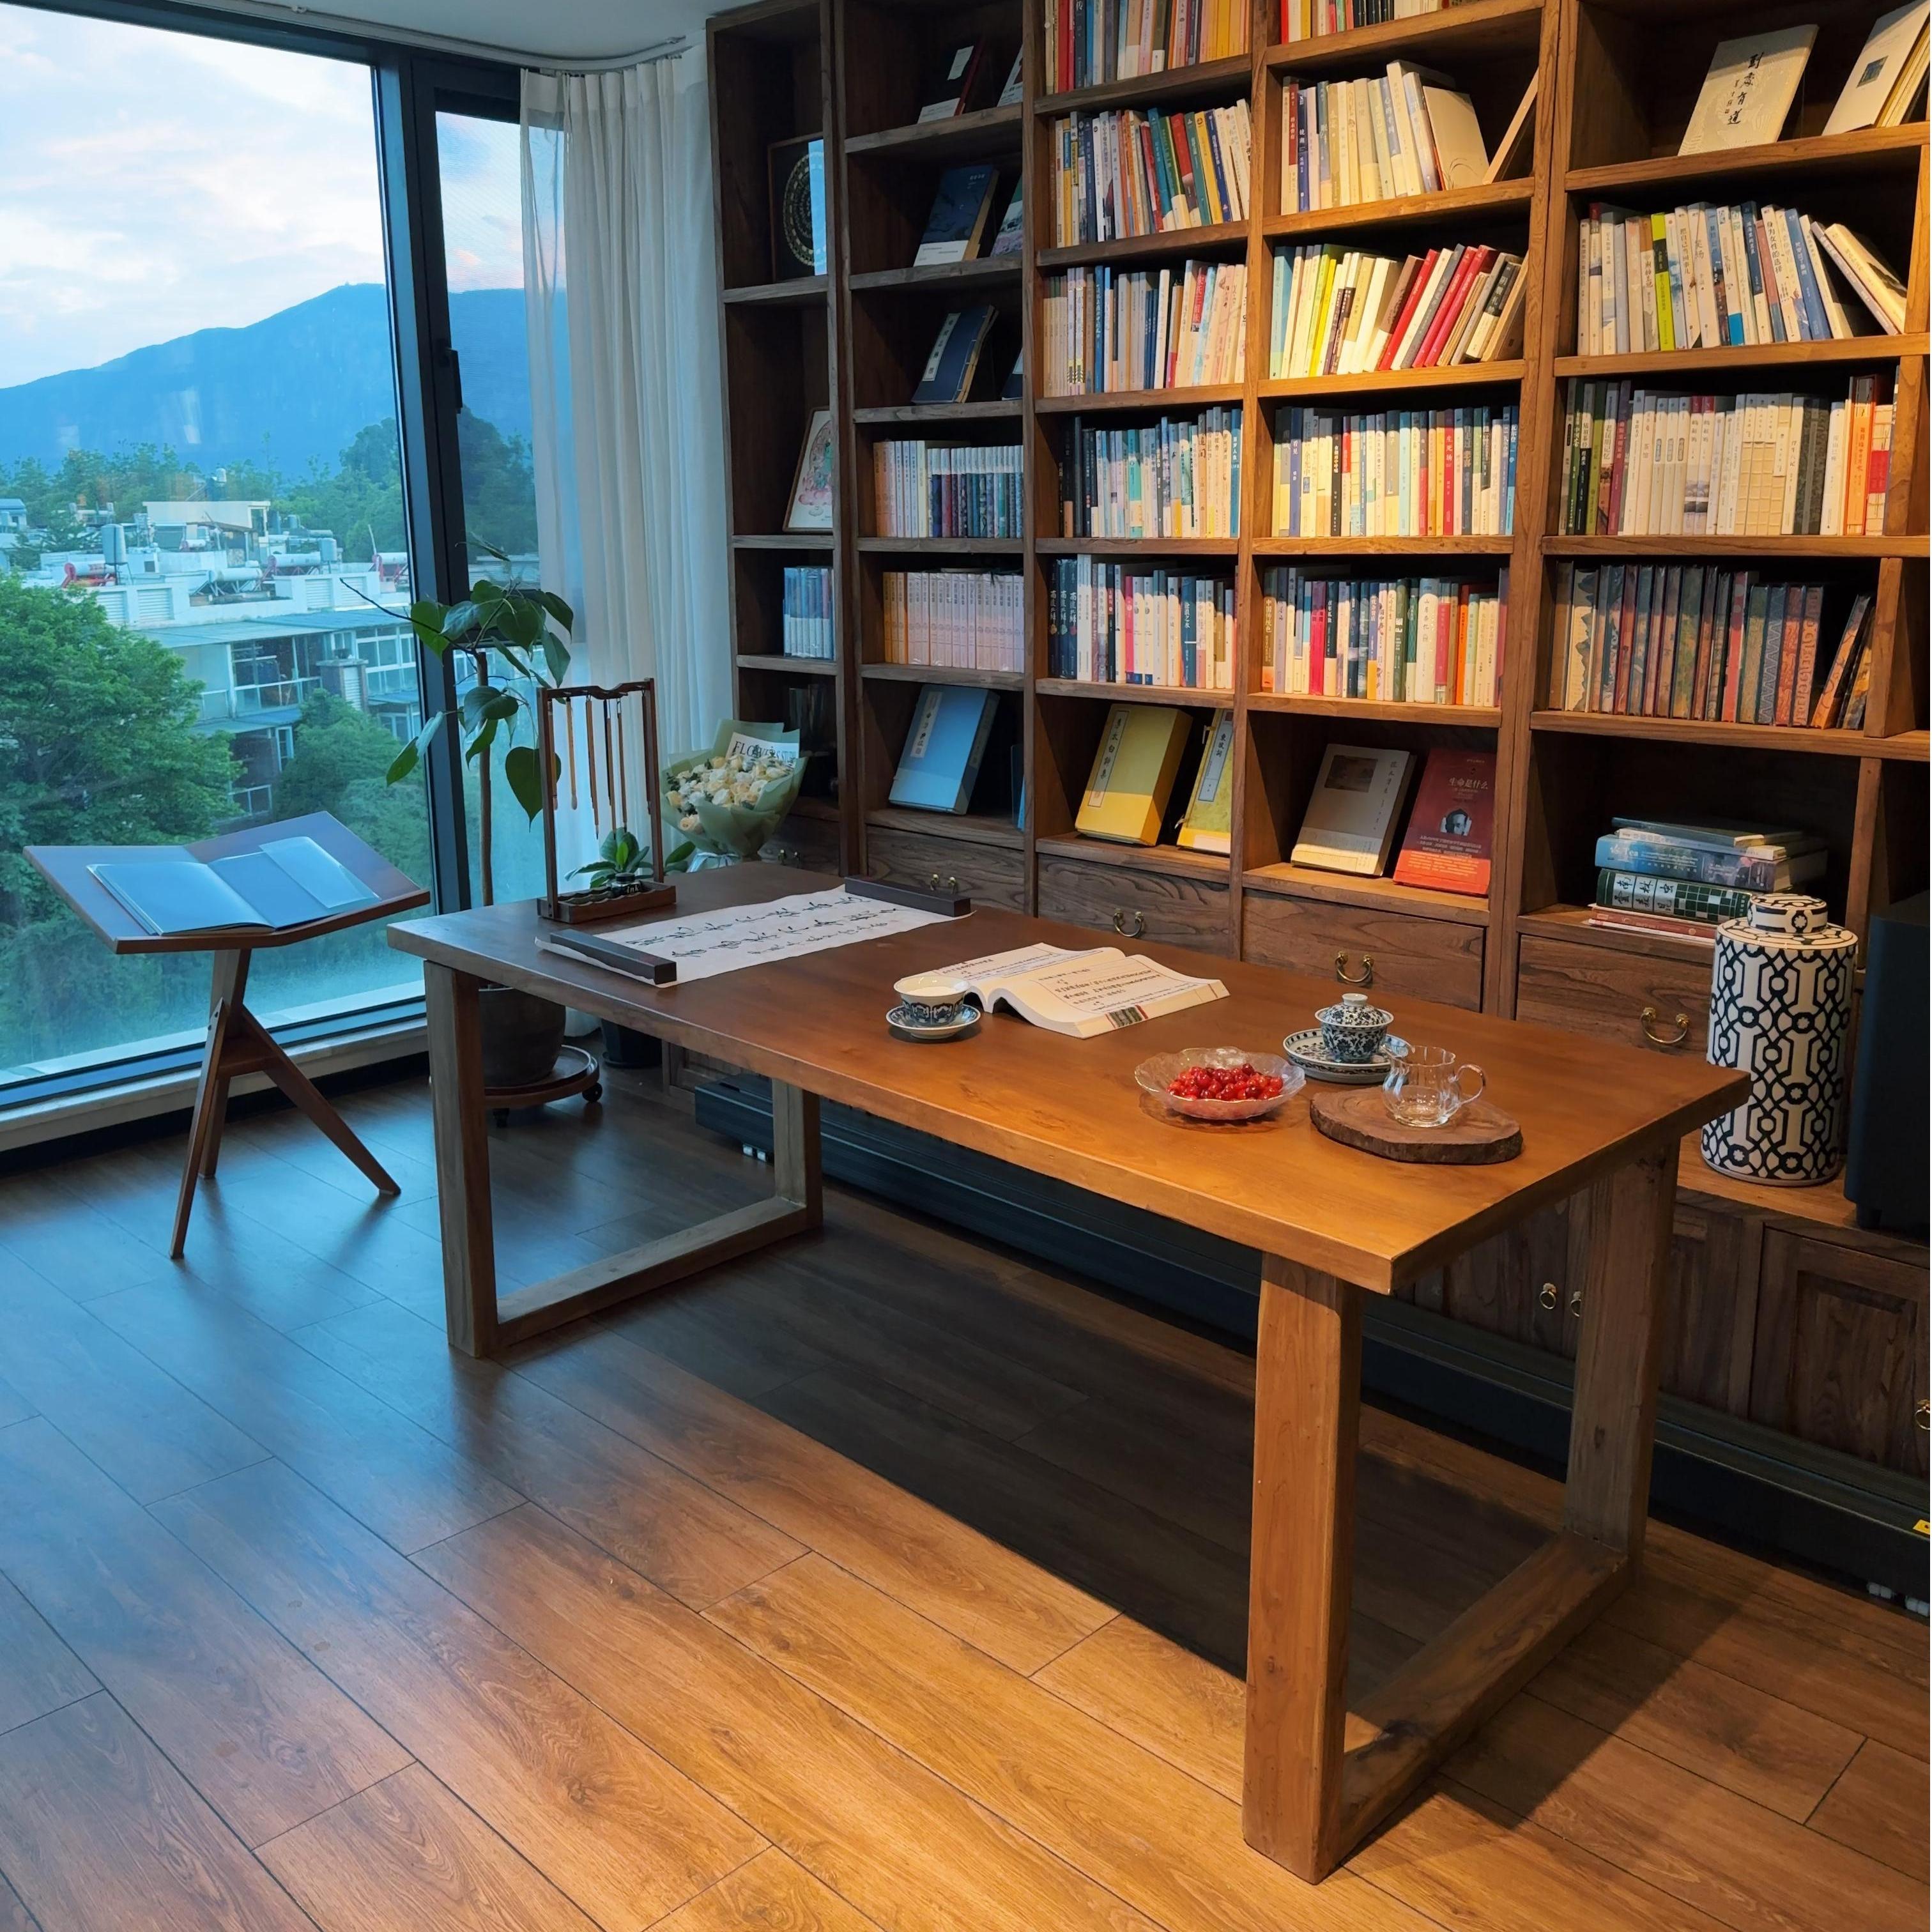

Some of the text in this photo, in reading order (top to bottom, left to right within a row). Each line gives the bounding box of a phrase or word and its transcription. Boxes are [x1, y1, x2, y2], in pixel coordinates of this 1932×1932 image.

[1292, 439, 1299, 455] 看见
[1449, 776, 1489, 790] 生命是什么
